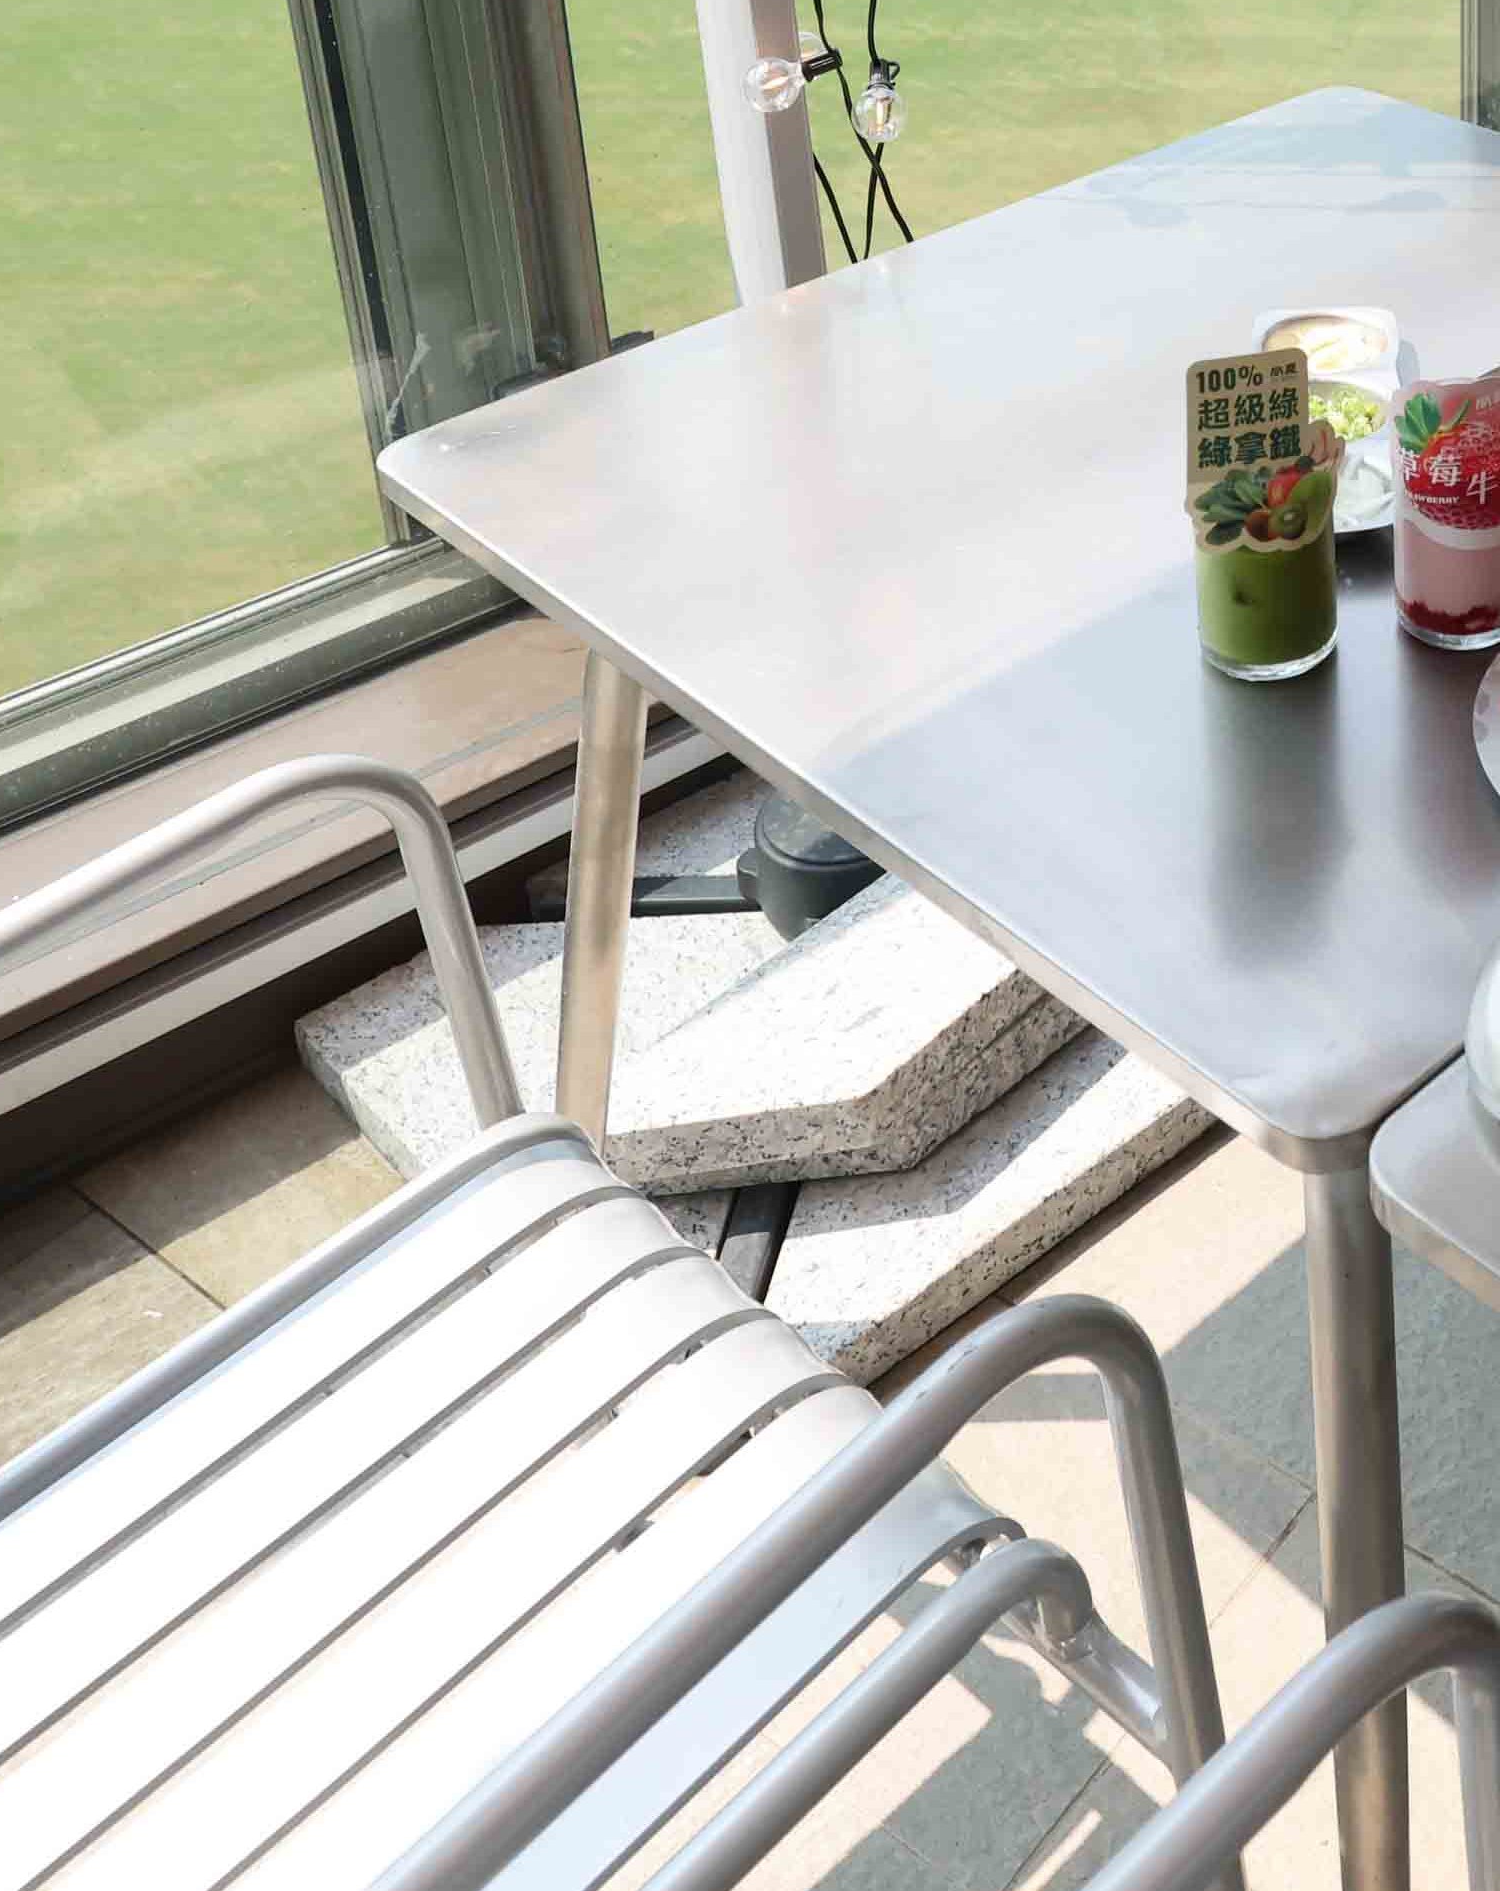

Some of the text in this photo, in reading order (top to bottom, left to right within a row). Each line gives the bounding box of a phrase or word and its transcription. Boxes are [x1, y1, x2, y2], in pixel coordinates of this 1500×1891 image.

[1196, 365, 1263, 394] 100%
[1198, 387, 1299, 431] 超級綠
